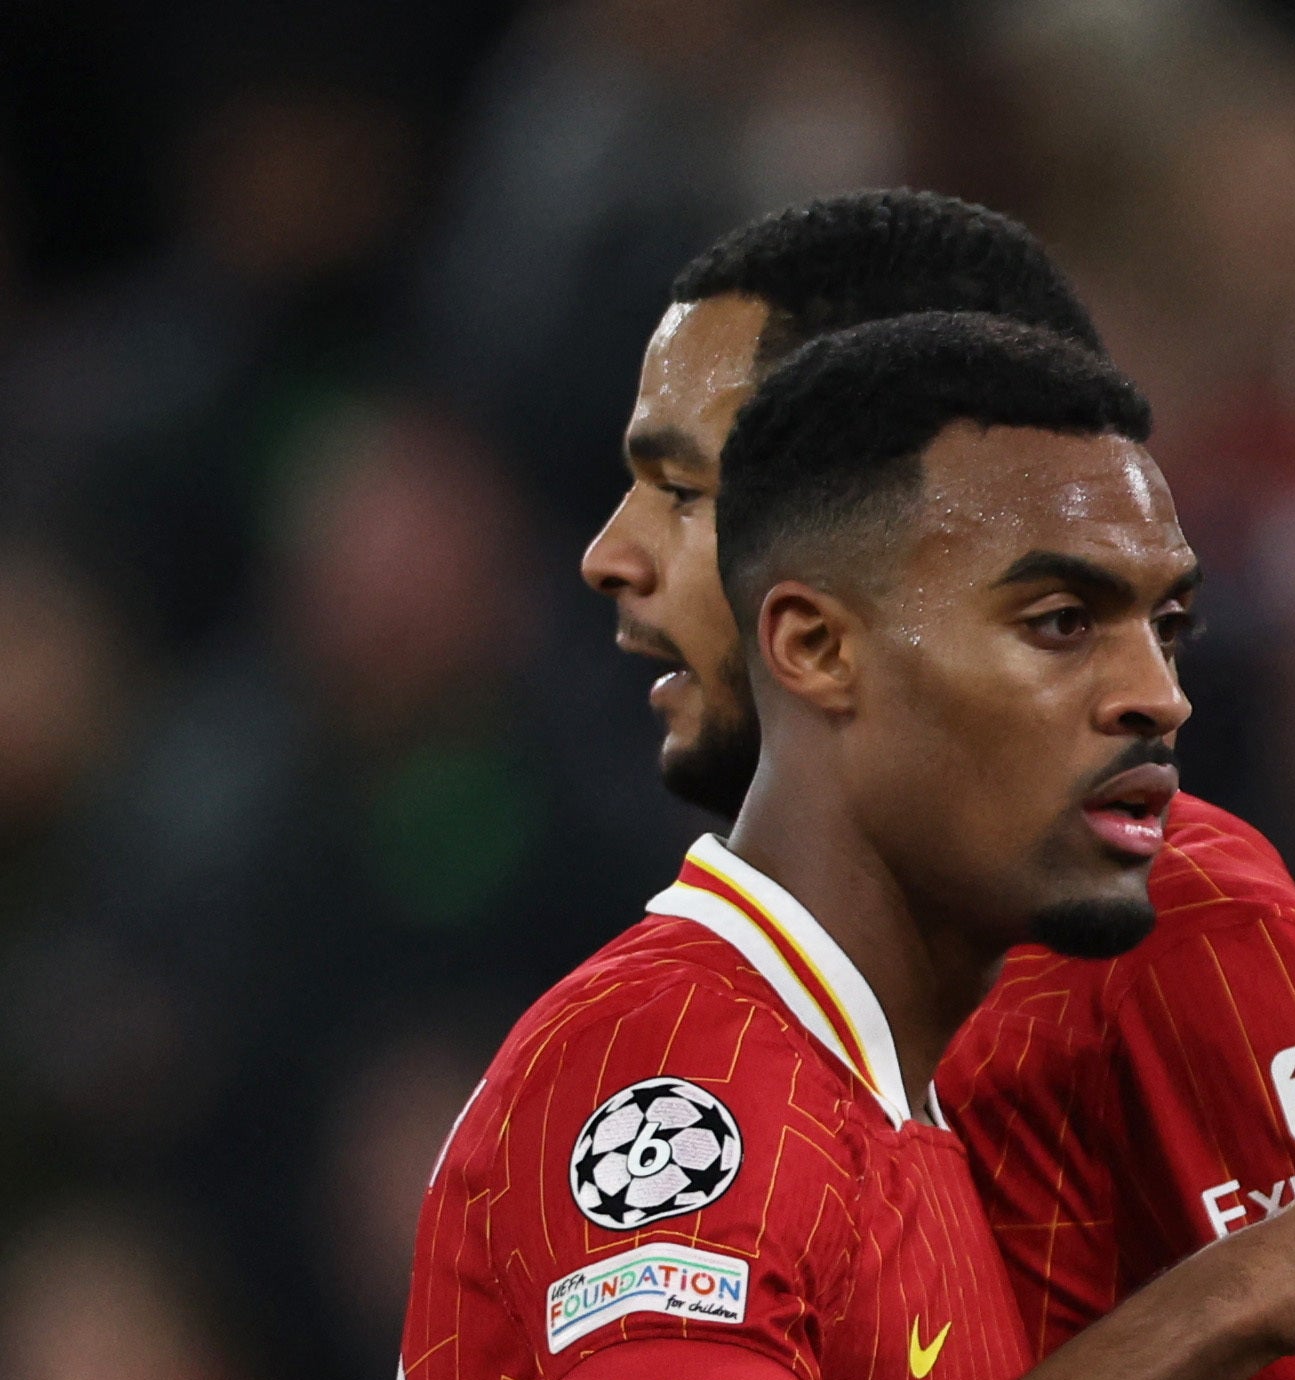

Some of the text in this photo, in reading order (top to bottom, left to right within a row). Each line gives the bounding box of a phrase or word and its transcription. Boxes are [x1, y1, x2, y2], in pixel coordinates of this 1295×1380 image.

[627, 1121, 672, 1178] 6
[551, 1272, 586, 1301] UEFA
[551, 1265, 741, 1328] FOUNDATION
[665, 1294, 737, 1320] for children
